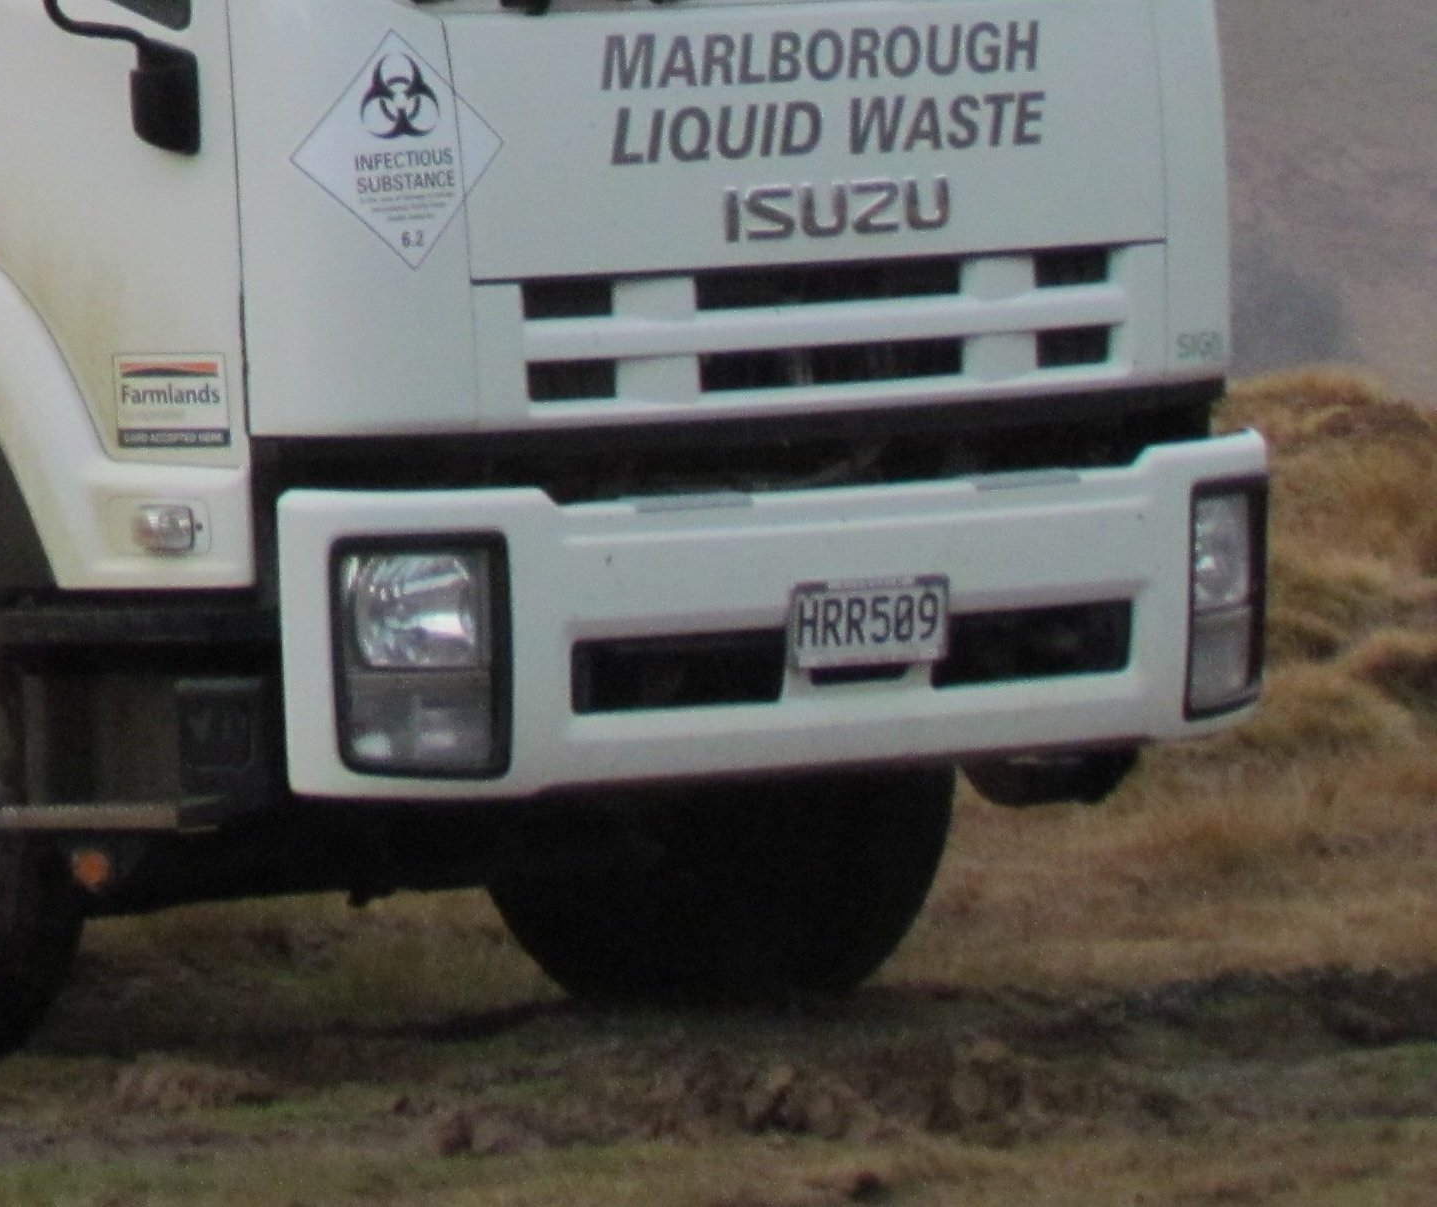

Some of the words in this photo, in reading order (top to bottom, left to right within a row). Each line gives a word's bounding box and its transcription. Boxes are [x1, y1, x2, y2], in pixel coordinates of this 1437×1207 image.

[601, 20, 1039, 91] MARLBOROUGH
[610, 102, 822, 166] LIQUID
[848, 92, 1045, 155] WASTE
[355, 148, 453, 171] INFECTIOUS
[357, 169, 455, 194] SUBSTANCE
[725, 177, 951, 243] ISUZU
[402, 230, 424, 248] 6.2
[120, 383, 220, 405] Farmlands
[797, 591, 939, 646] HRR509
